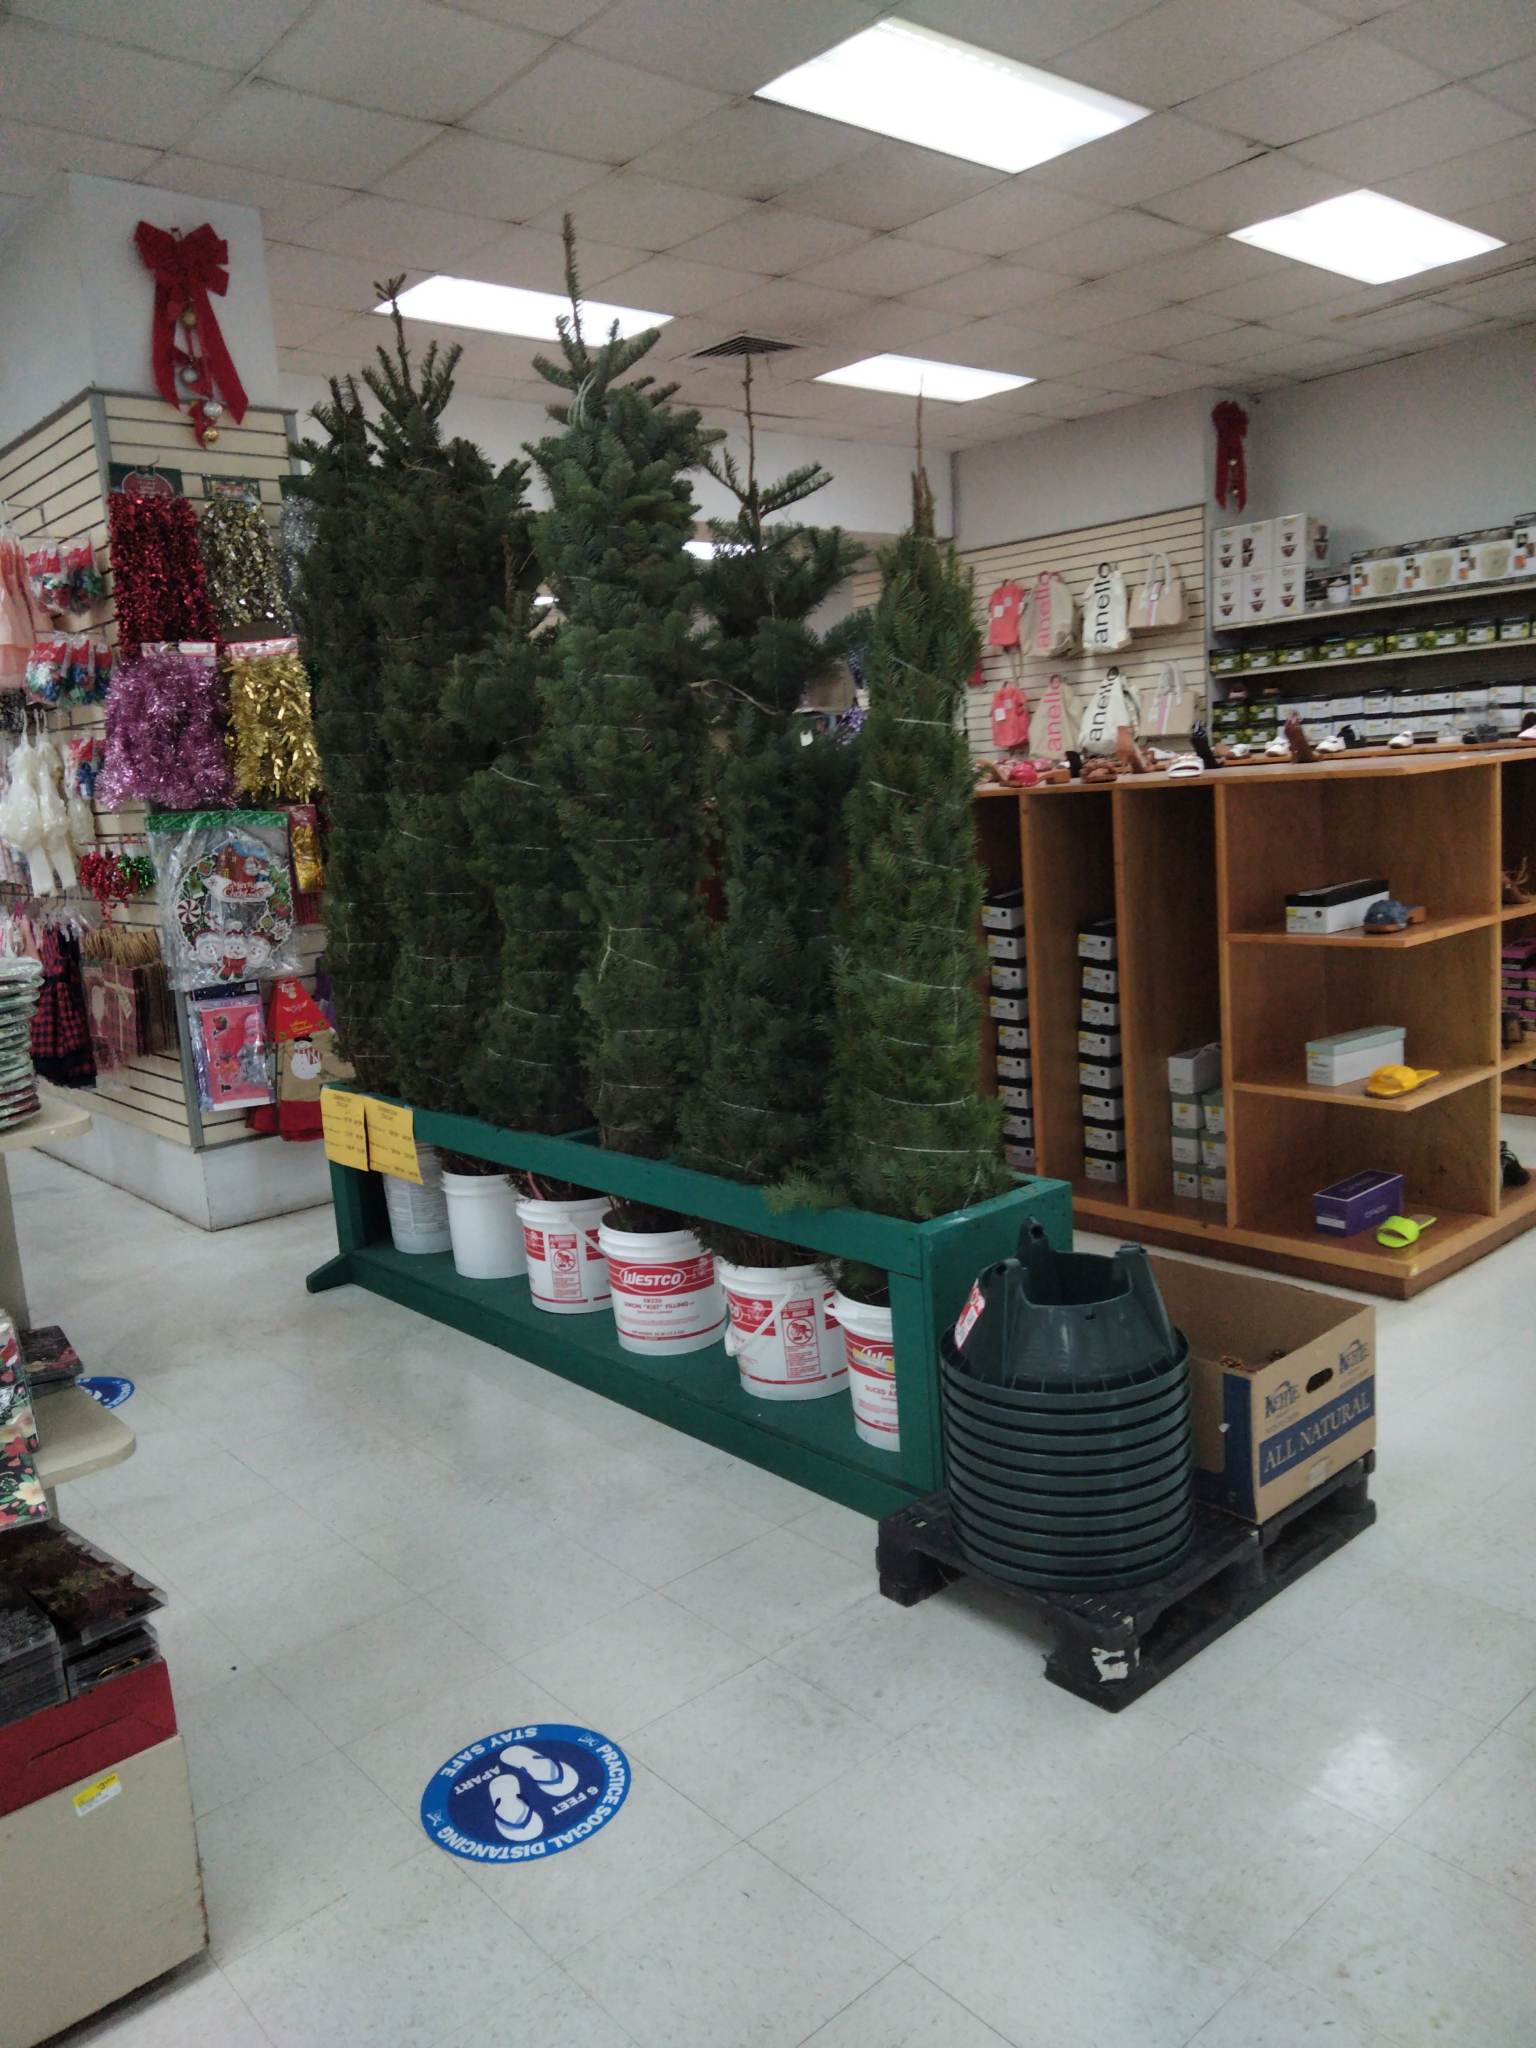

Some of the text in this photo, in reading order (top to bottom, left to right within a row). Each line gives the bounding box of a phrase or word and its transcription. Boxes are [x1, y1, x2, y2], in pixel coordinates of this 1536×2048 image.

[1034, 570, 1051, 649] anello
[1092, 562, 1112, 644] anello
[1043, 674, 1061, 752] anello
[1089, 666, 1120, 742] anello
[623, 1271, 682, 1286] WESTCO
[1263, 1391, 1371, 1473] ALL NATURAL
[440, 1727, 538, 1779] STAY SAFE
[454, 1765, 501, 1796] APART
[437, 1744, 625, 1860] PRACTICE SOCIAL DISTANCING
[551, 1786, 599, 1816] 6 FEET
